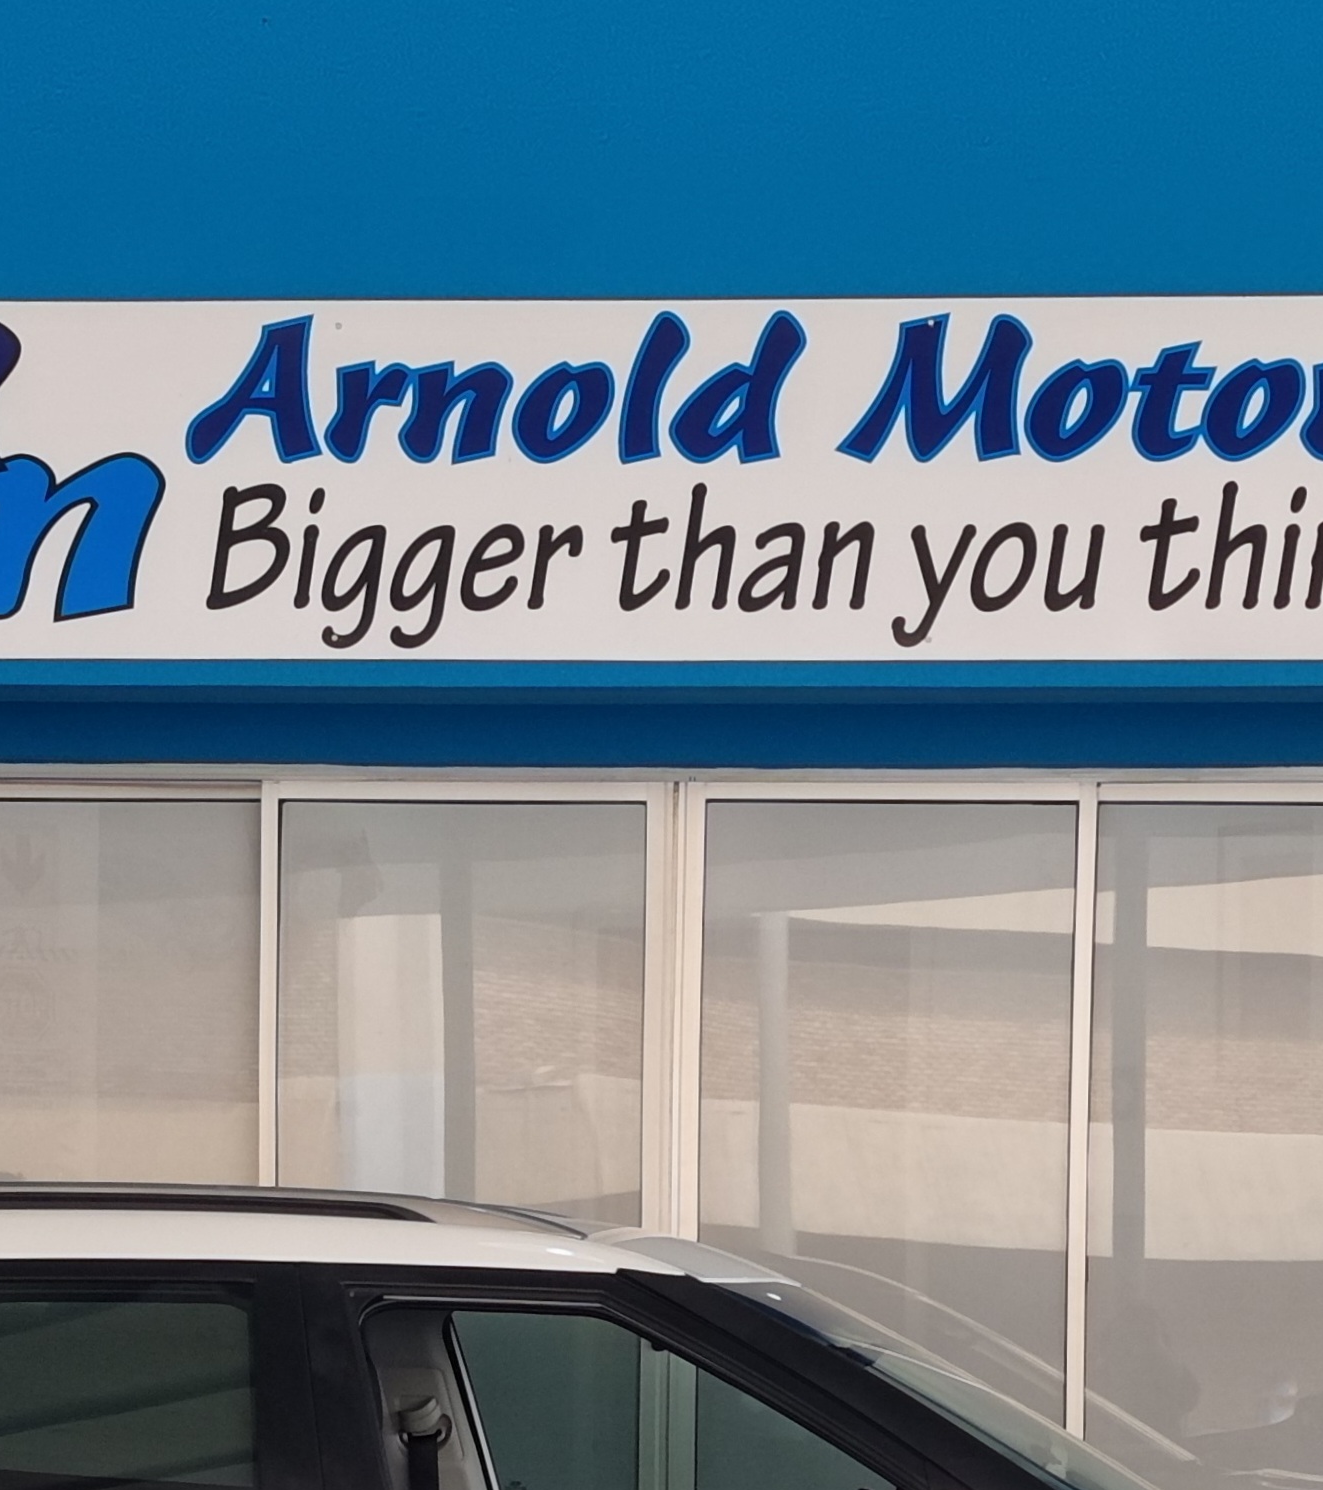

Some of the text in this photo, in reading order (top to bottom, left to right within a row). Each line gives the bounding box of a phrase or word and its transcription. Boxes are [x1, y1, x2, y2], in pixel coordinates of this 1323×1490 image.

[185, 310, 807, 464] Arnold
[206, 482, 583, 649] Bigger
[610, 482, 880, 613] than
[890, 520, 1106, 649] you
